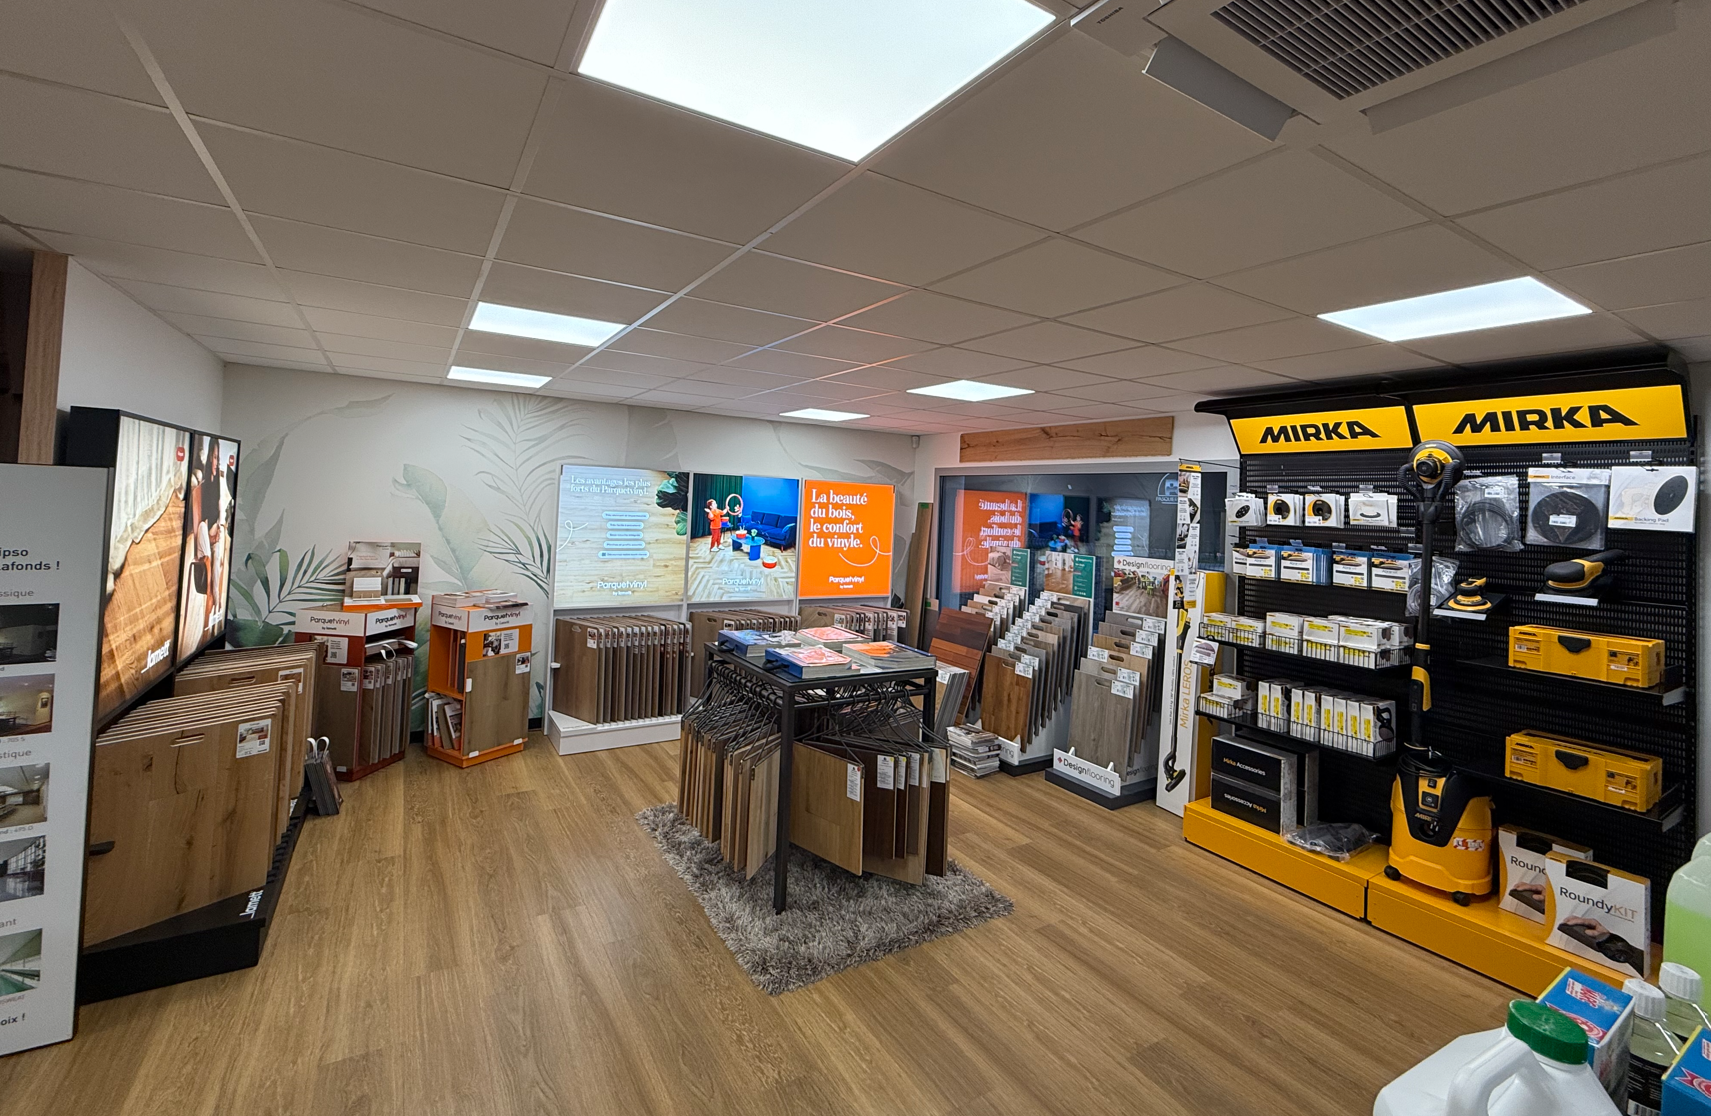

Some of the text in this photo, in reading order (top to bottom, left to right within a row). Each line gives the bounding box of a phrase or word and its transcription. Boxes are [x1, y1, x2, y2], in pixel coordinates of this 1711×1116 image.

[1452, 404, 1641, 434] MIRKA
[1259, 420, 1382, 444] MIRKA
[570, 484, 588, 492] forts
[590, 485, 600, 493] du
[571, 475, 651, 489] Les avantages les plus
[811, 488, 868, 505] La beauté
[810, 503, 855, 521] du bois,
[809, 518, 863, 534] le confort
[808, 533, 863, 551] du vinyle.
[0, 560, 51, 571] afonds
[1122, 559, 1172, 572] Designflooring
[597, 580, 647, 590] Parquetvinyl
[722, 577, 764, 586] Parquetvinyl
[828, 576, 865, 584] Parquetvinyl
[310, 616, 350, 626] Parquetvinyl
[375, 613, 407, 625] Parquetvinyl
[484, 611, 521, 621] Parquetvinyl
[1179, 660, 1193, 729] Mirka LEROS
[1063, 758, 1115, 788] Designflooring
[1236, 762, 1266, 776] Accessories
[1560, 886, 1638, 920] RoundyKIT
